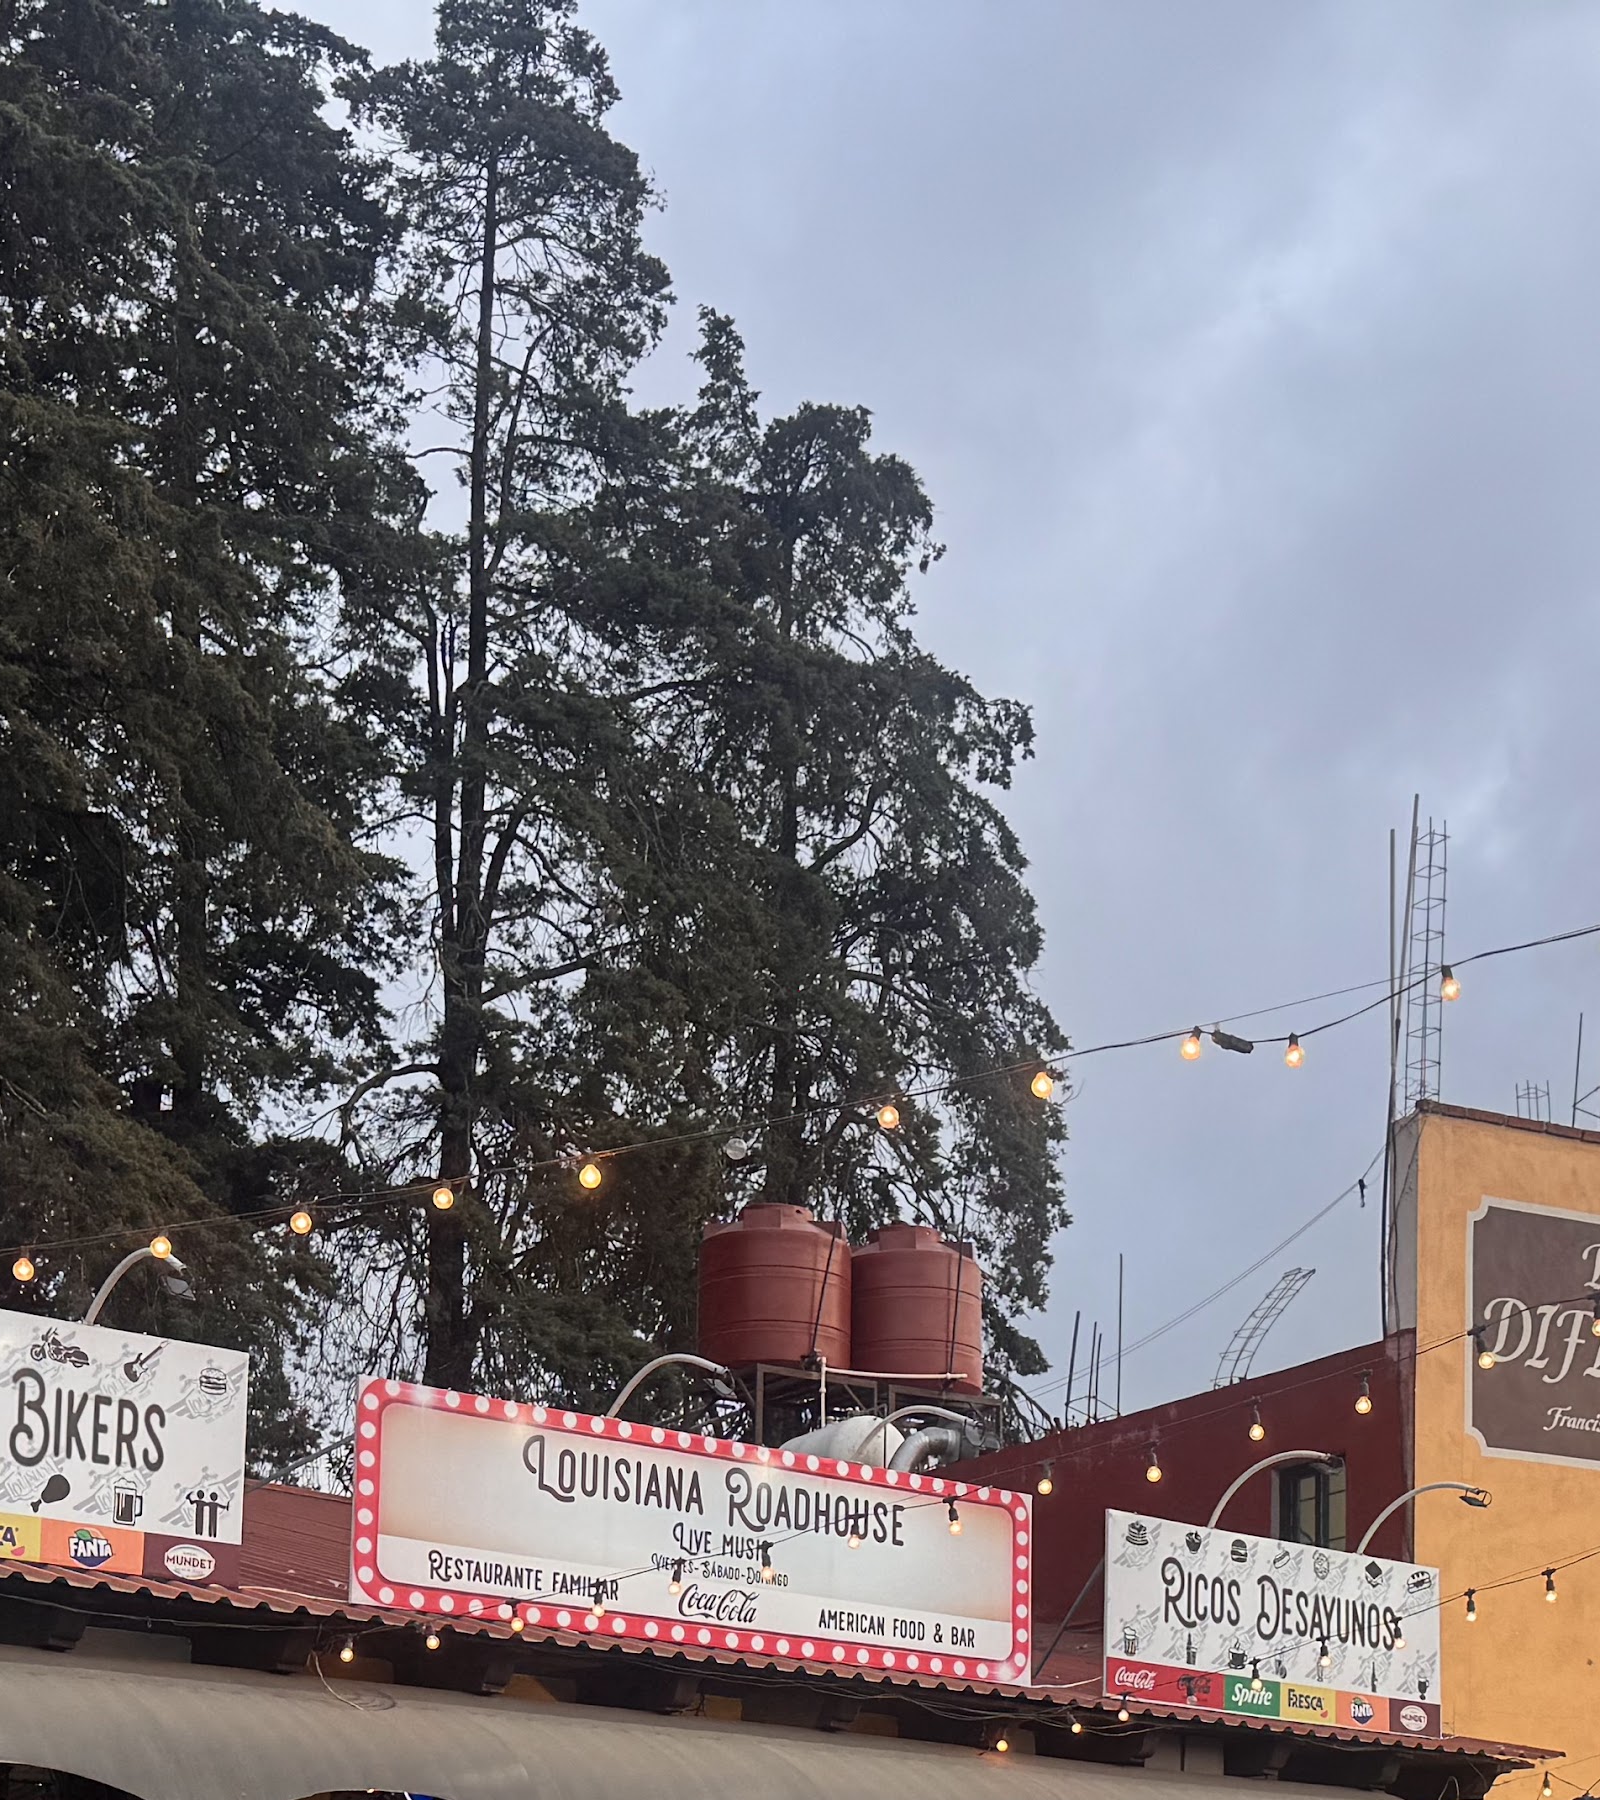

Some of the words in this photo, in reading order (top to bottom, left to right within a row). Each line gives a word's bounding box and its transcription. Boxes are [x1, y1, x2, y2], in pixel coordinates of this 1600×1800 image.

[9, 1368, 166, 1472] BIKERS
[522, 1434, 705, 1516] LOUISIANA
[724, 1466, 905, 1548] ROADHOUSE
[68, 1536, 113, 1558] FANTA
[673, 1522, 712, 1557] LIVE
[721, 1534, 764, 1561] MUSI
[165, 1553, 214, 1571] MUNDET
[428, 1549, 543, 1593] RESTAURANTE
[552, 1571, 619, 1601] FAMILAR
[678, 1584, 760, 1624] Coca-Cola
[1161, 1557, 1241, 1629] RICOS
[1257, 1574, 1397, 1652] DESAYUNOS
[818, 1608, 885, 1638] AMERICAN
[892, 1616, 928, 1641] FOOD
[933, 1623, 944, 1644] &
[950, 1624, 975, 1649] BAR
[1115, 1666, 1157, 1691] Coca-Cola
[1232, 1682, 1273, 1707] Sprite
[1288, 1688, 1324, 1711] FRESCA
